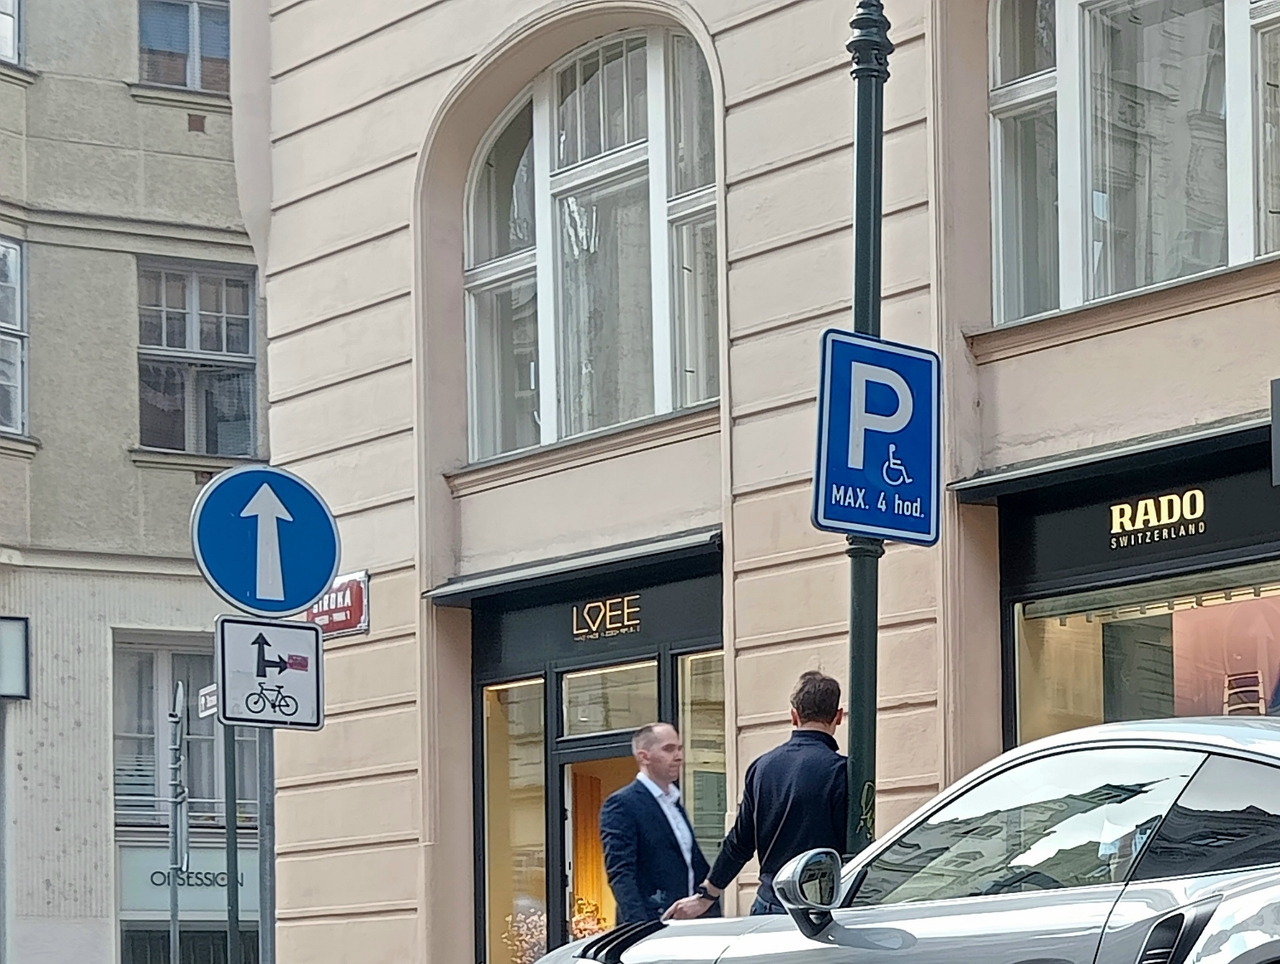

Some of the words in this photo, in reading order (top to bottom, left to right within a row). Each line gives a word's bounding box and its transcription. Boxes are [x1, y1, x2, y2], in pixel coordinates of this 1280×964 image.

[847, 361, 914, 470] P
[831, 484, 869, 510] MAX.
[877, 491, 887, 512] 4
[894, 494, 925, 518] hod.
[1110, 489, 1205, 534] RADO
[1110, 521, 1205, 549] SWITZERLAND
